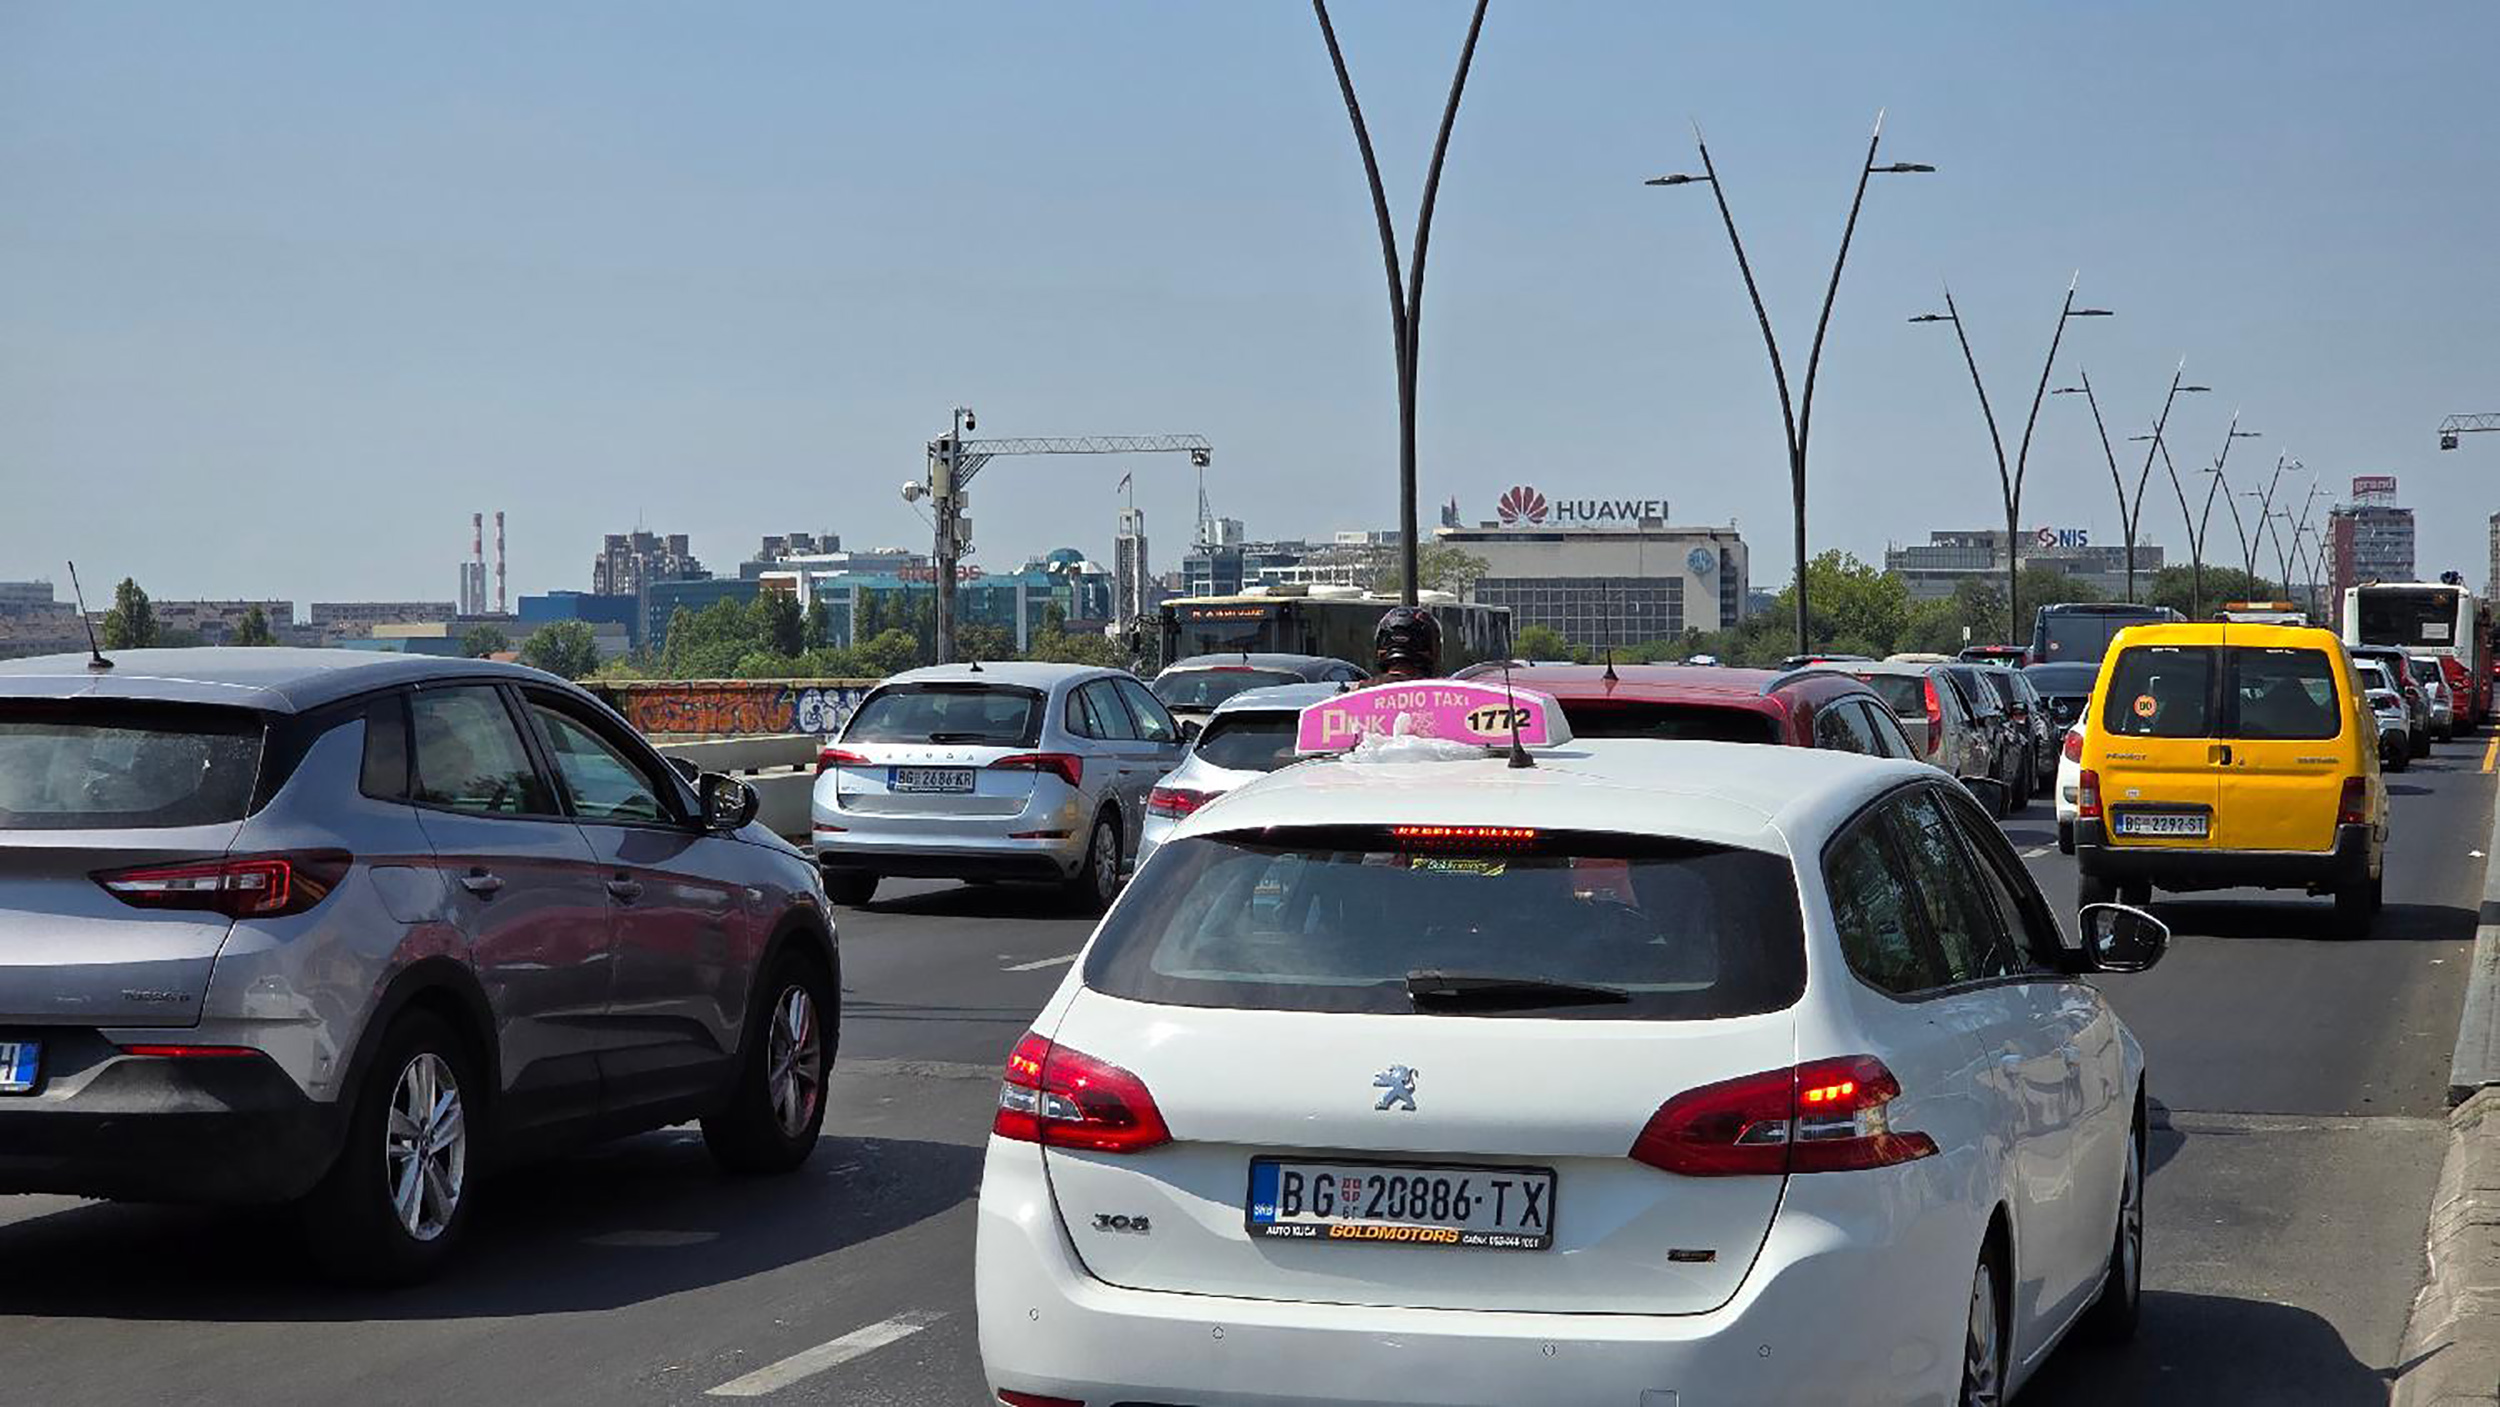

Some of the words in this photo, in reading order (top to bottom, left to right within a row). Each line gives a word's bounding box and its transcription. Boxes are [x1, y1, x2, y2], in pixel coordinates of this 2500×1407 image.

[2355, 478, 2394, 492] grand
[1556, 500, 1669, 520] HUAWEI
[2060, 529, 2087, 547] NIS
[1374, 692, 1426, 710] RADIO
[1433, 691, 1469, 708] TAXI
[1467, 709, 1531, 731] 1772
[898, 771, 914, 784] BG
[2126, 817, 2141, 830] BG
[2152, 818, 2204, 832] 2292-ST
[1281, 1171, 1336, 1218] BG
[1091, 1213, 1150, 1233] 308
[1266, 1226, 1291, 1237] AUTO
[1329, 1225, 1459, 1243] GOLDMOTORS
